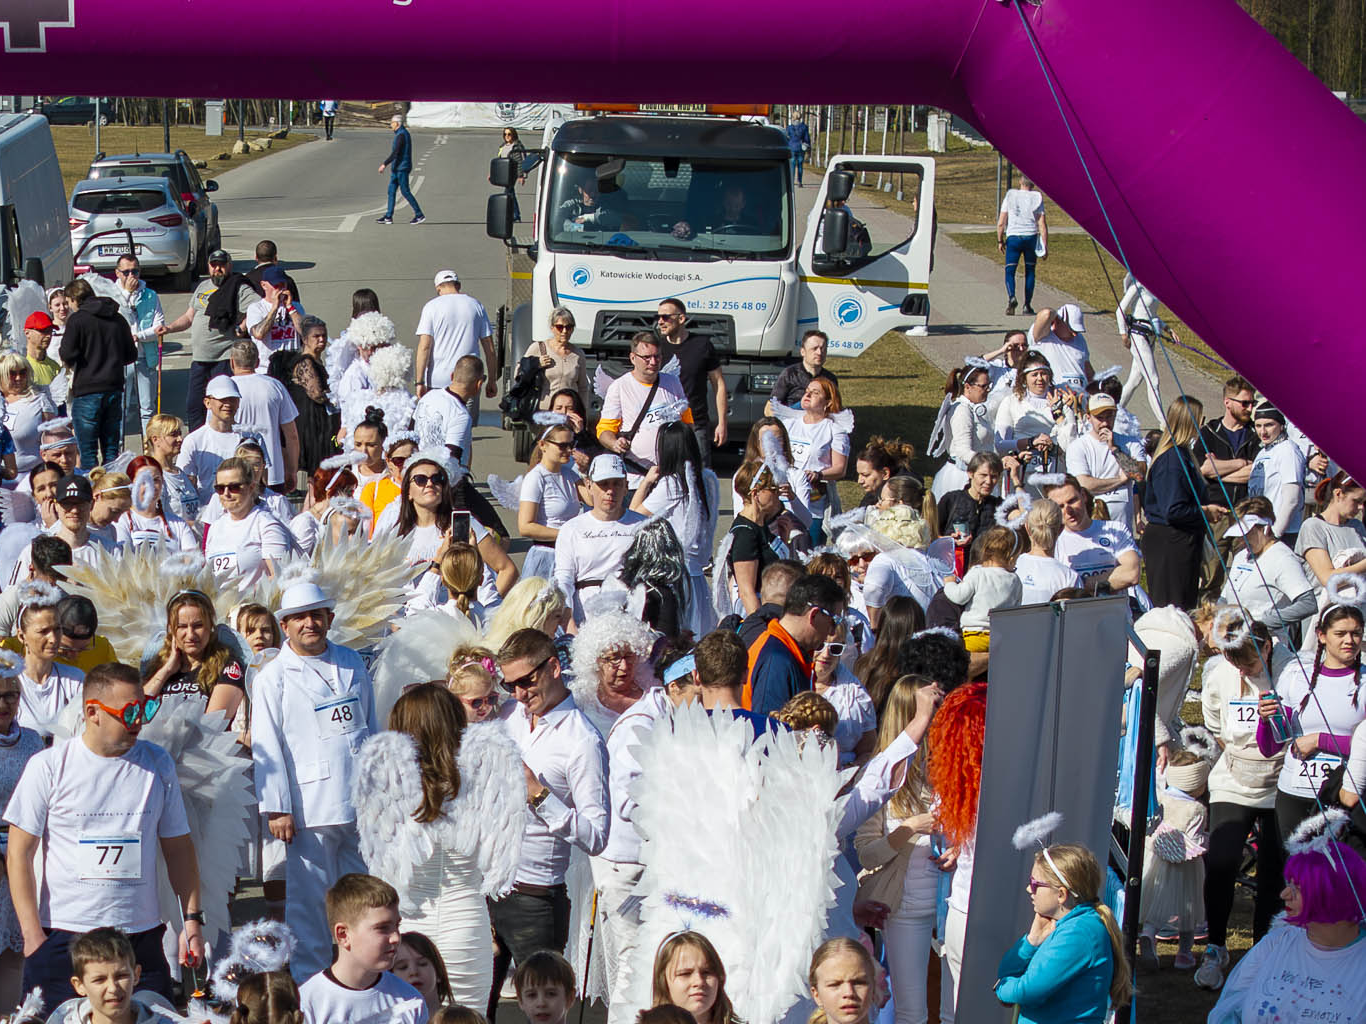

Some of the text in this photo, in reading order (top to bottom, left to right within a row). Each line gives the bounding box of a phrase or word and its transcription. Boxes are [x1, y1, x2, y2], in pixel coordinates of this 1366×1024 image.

[600, 270, 703, 282] Katowickie Wodociągi S.A.
[687, 300, 767, 311] tel.: 32 256 48 09
[842, 341, 852, 349] 48
[853, 342, 864, 350] 09
[331, 705, 353, 723] 48
[1237, 706, 1261, 722] 12
[1299, 761, 1331, 778] 219
[96, 845, 124, 865] 77
